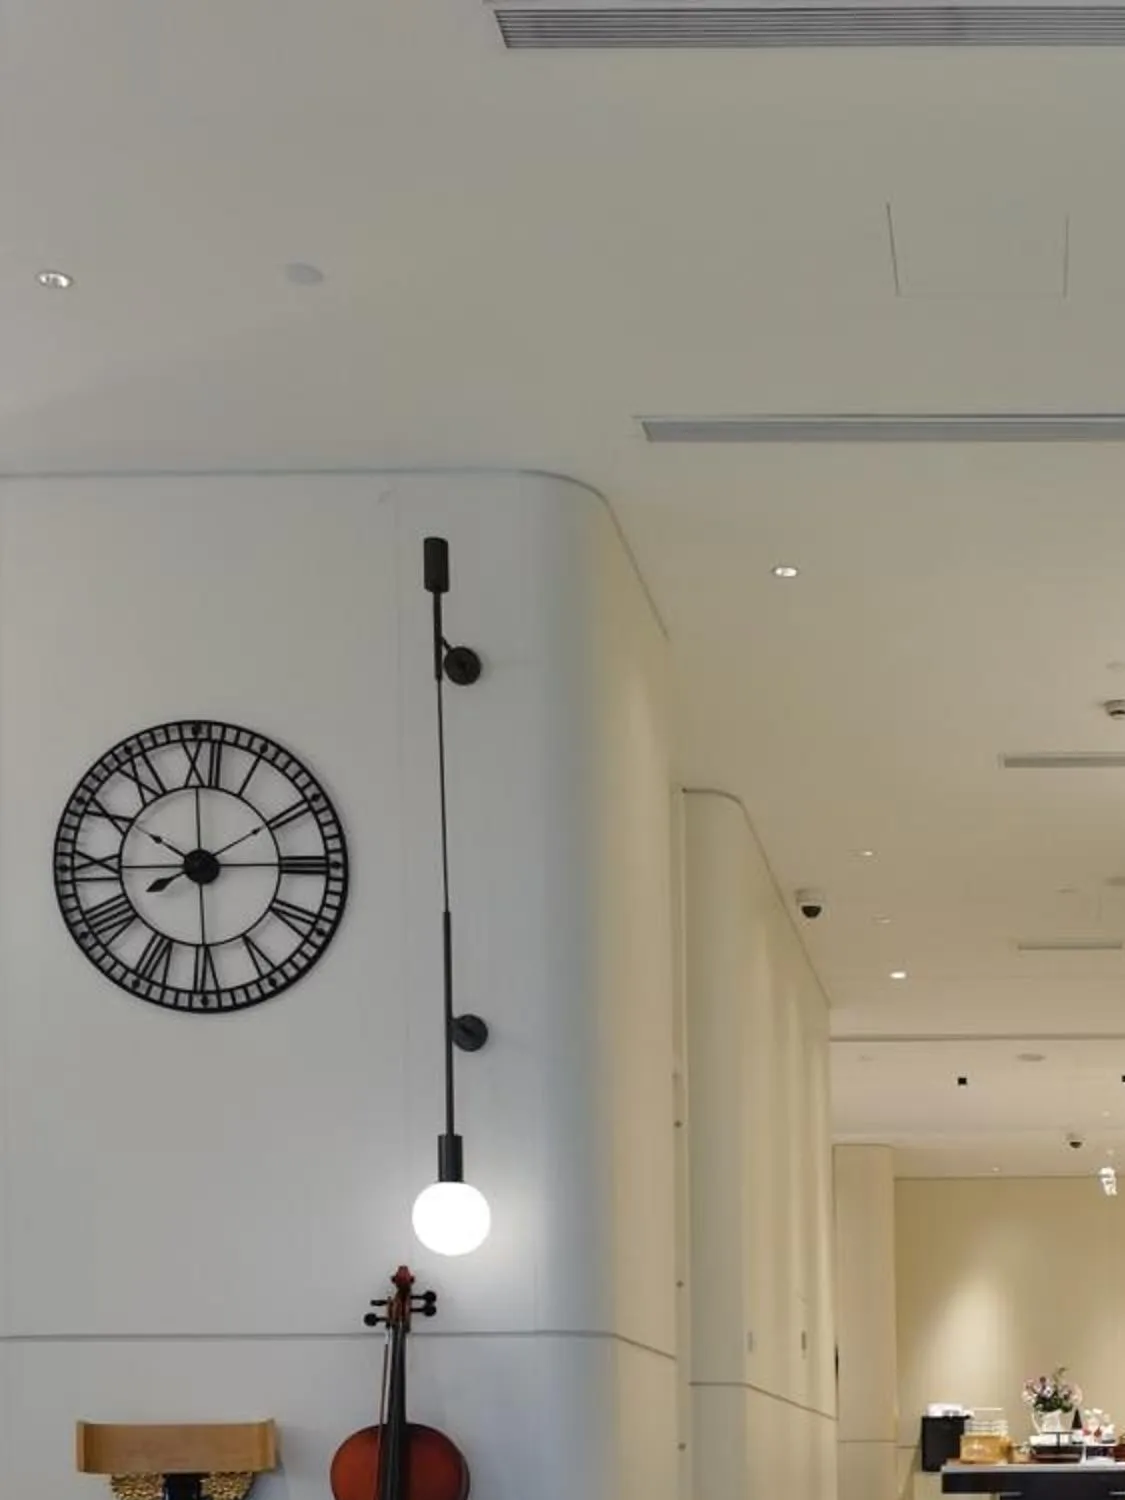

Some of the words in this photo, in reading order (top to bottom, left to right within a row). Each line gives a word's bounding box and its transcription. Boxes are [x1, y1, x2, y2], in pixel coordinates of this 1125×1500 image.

[114, 752, 168, 806] XI
[180, 740, 223, 788] XII
[84, 798, 135, 836] X
[265, 798, 313, 831] II
[73, 850, 121, 882] IX
[279, 855, 328, 875] III
[133, 931, 174, 986] VII
[193, 945, 221, 992] VI
[243, 932, 278, 978] V
